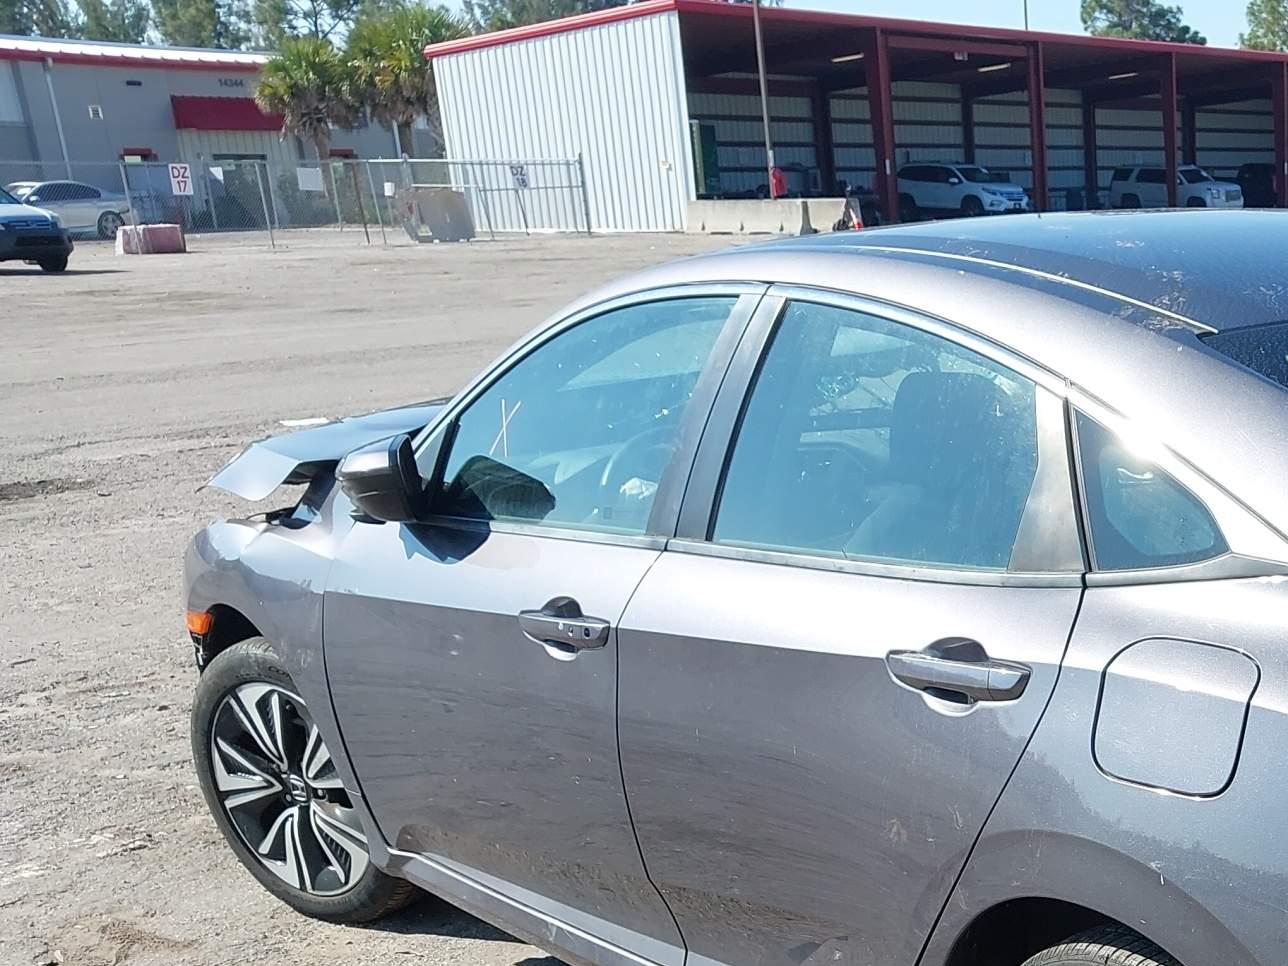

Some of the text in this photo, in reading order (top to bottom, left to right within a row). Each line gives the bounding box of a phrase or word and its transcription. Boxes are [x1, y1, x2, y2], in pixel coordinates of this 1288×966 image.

[171, 166, 189, 179] DZ
[510, 165, 526, 177] DZ
[177, 180, 188, 192] 17
